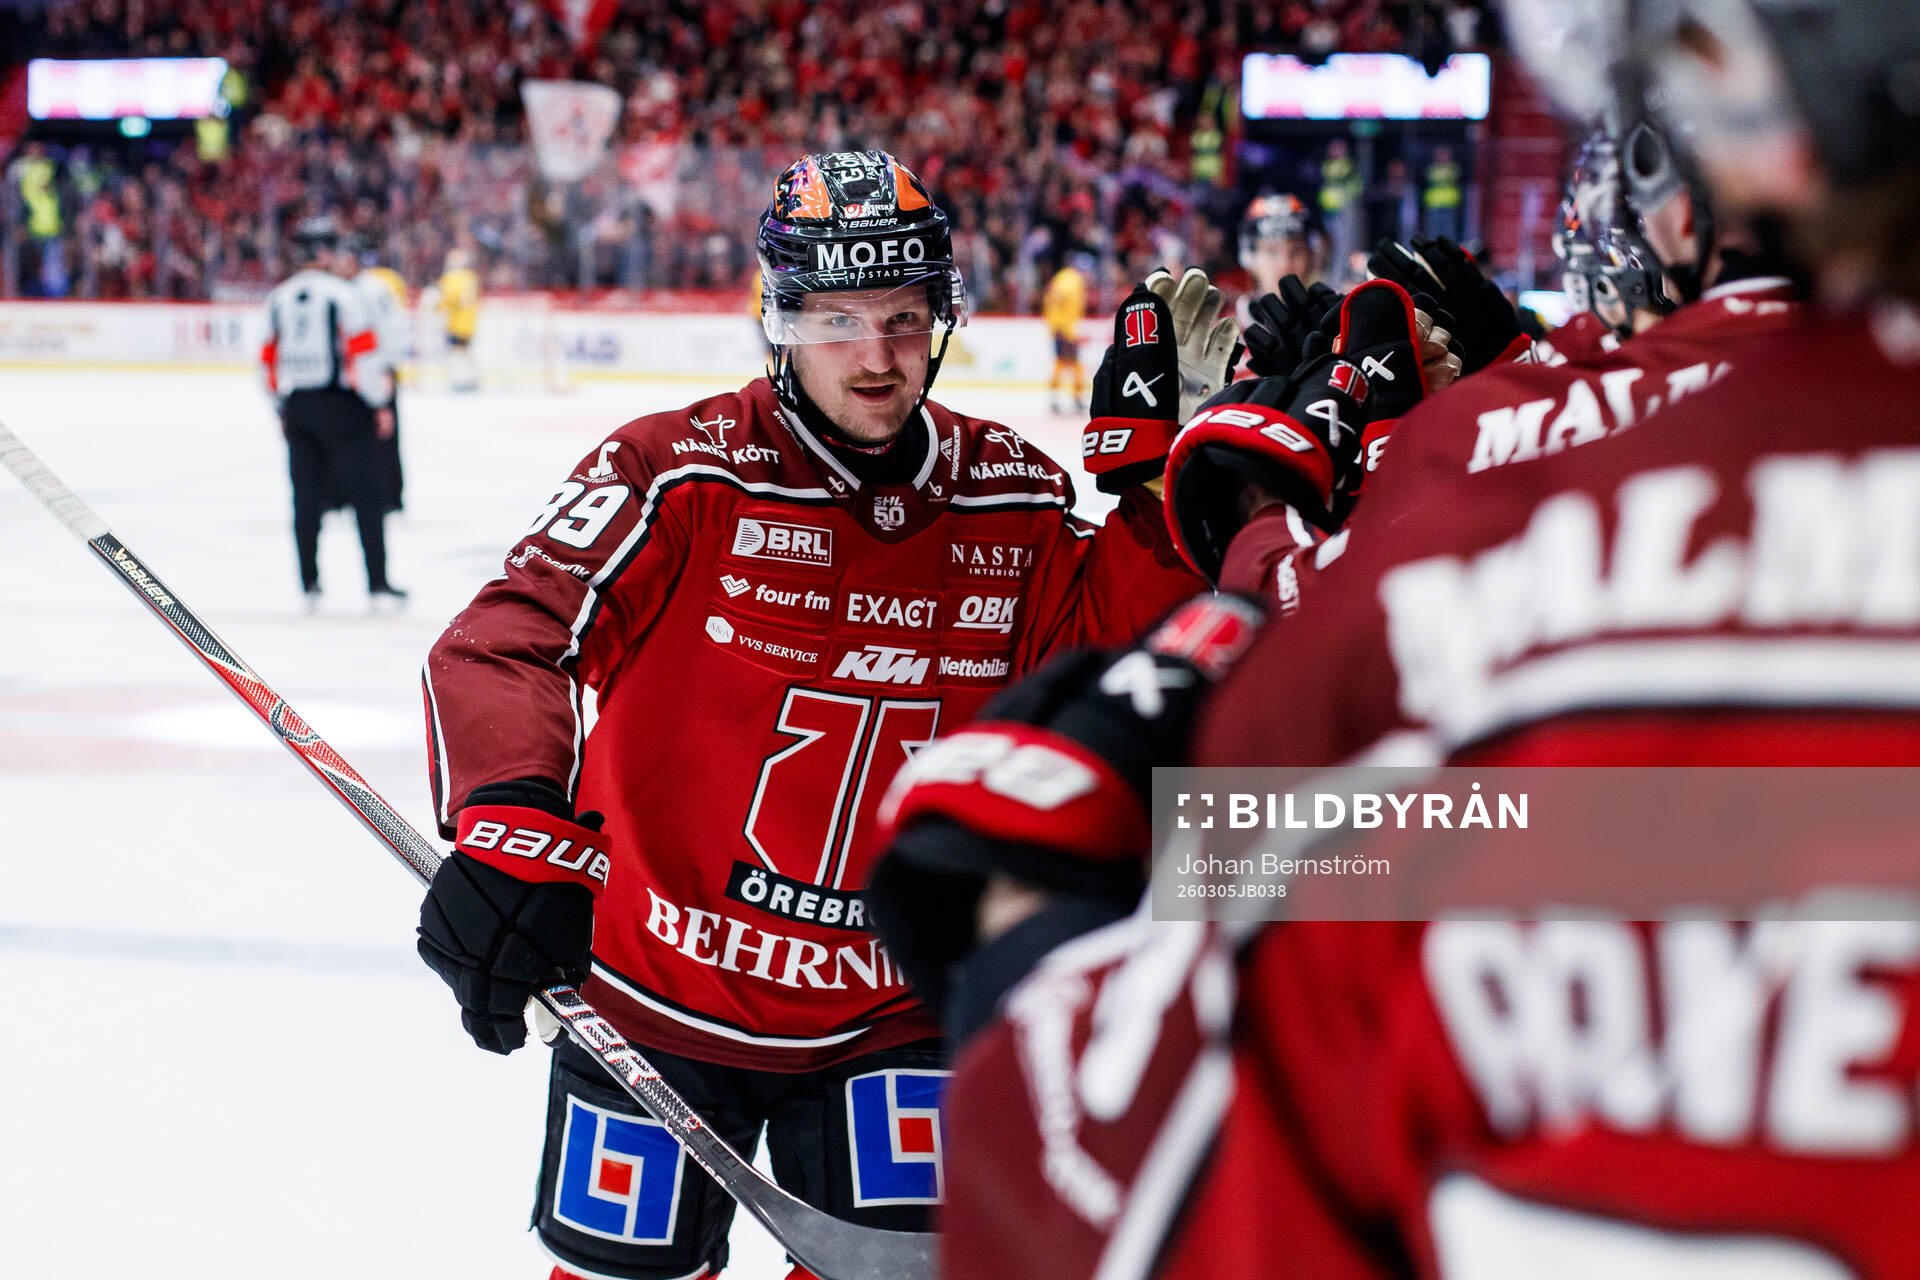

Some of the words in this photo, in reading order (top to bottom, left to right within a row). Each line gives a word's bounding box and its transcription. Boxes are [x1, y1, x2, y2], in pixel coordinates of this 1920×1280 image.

[849, 218, 898, 229] BAUER
[816, 237, 926, 271] MOFO
[850, 269, 900, 280] BOSTAD
[732, 444, 780, 465] KÖTT
[970, 461, 1027, 480] NÄRKE
[874, 496, 904, 506] SHL
[874, 506, 906, 531] 50
[766, 527, 828, 556] BRL
[766, 549, 828, 562] ELECTRONICS
[968, 567, 1021, 578] INTERIÖR
[755, 584, 801, 607] four
[804, 590, 830, 611] fm
[847, 593, 937, 628] EXACT
[959, 595, 1019, 624] OBK
[739, 634, 763, 651] VVS
[763, 643, 819, 663] SERVICE
[832, 645, 931, 685] KTM
[461, 820, 611, 890] BAUE
[740, 869, 874, 928] ÖREBR
